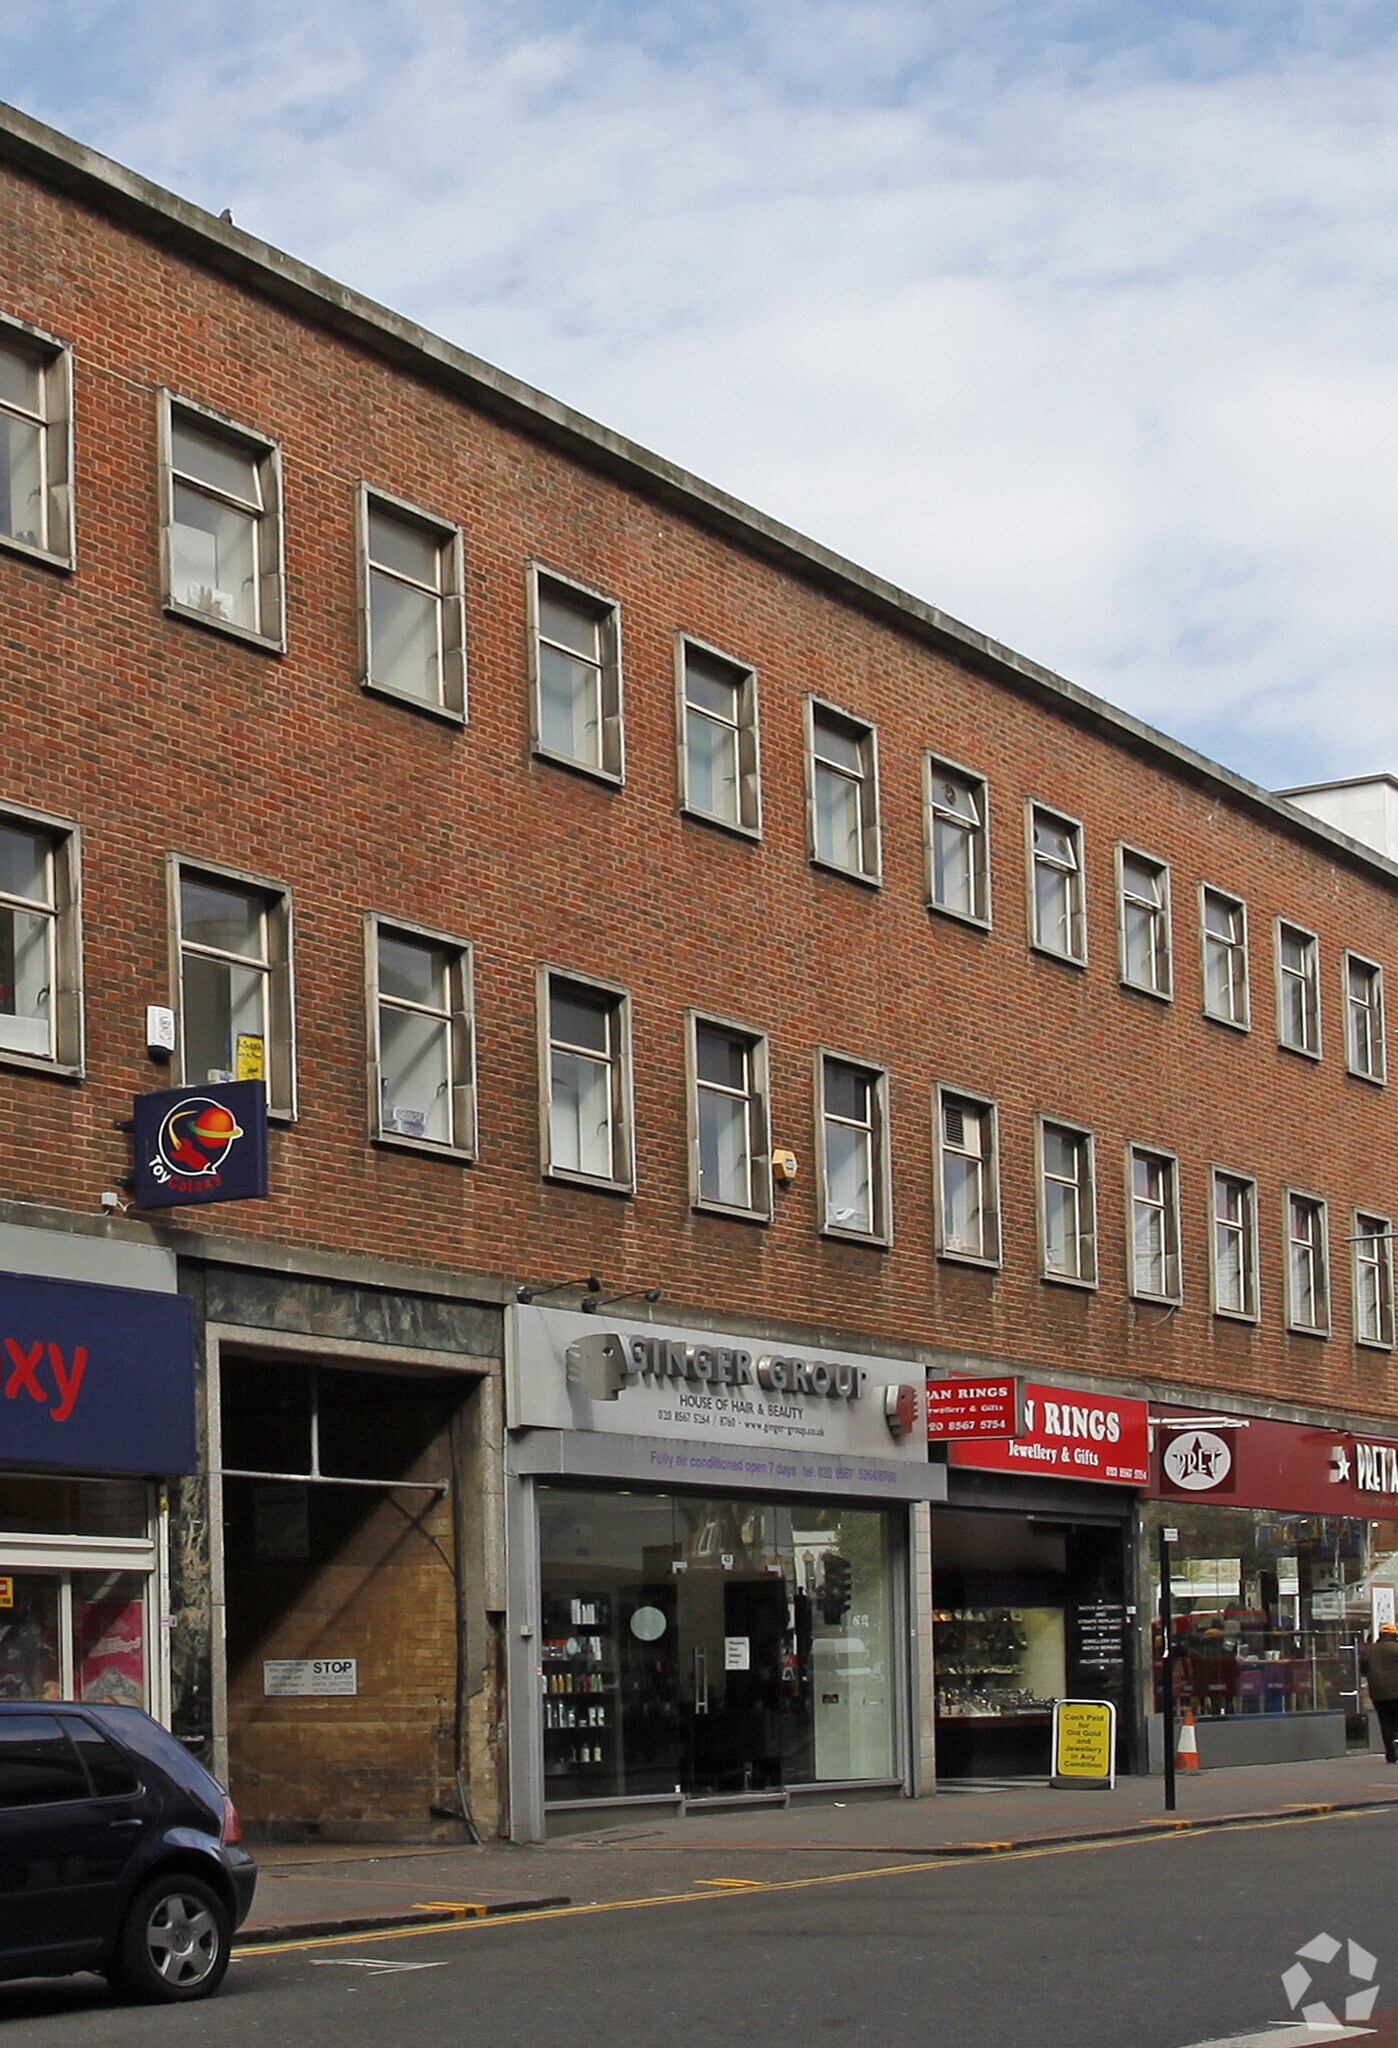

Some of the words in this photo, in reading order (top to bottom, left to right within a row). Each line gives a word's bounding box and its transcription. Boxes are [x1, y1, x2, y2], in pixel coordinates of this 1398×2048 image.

[149, 1155, 172, 1184] Toy
[629, 1334, 753, 1385] GINGER
[758, 1354, 869, 1400] GROUP
[0, 1337, 89, 1422] xy
[958, 1387, 1008, 1399] RINGS
[679, 1394, 712, 1411] HOUSE
[715, 1398, 729, 1411] OF
[731, 1400, 755, 1415] HAIR
[757, 1403, 765, 1416] &
[767, 1404, 804, 1420] BEAUTY
[969, 1404, 977, 1413] &
[981, 1404, 1004, 1412] Gifts
[928, 1421, 944, 1431] 20
[947, 1421, 975, 1431] 8567
[980, 1419, 1006, 1430] 5754
[1043, 1402, 1120, 1443] RINGS
[1008, 1439, 1057, 1464] Jewellery
[1061, 1446, 1070, 1463] &
[1074, 1447, 1099, 1466] Gifts
[1177, 1447, 1220, 1475] PRET
[745, 1461, 768, 1476] open
[313, 1661, 352, 1674] STOP
[1064, 1713, 1084, 1721] Cash
[1083, 1729, 1102, 1737] Gold
[1065, 1744, 1102, 1753] Jewellery
[1080, 1753, 1096, 1761] Any
[1064, 1760, 1103, 1769] Condition
